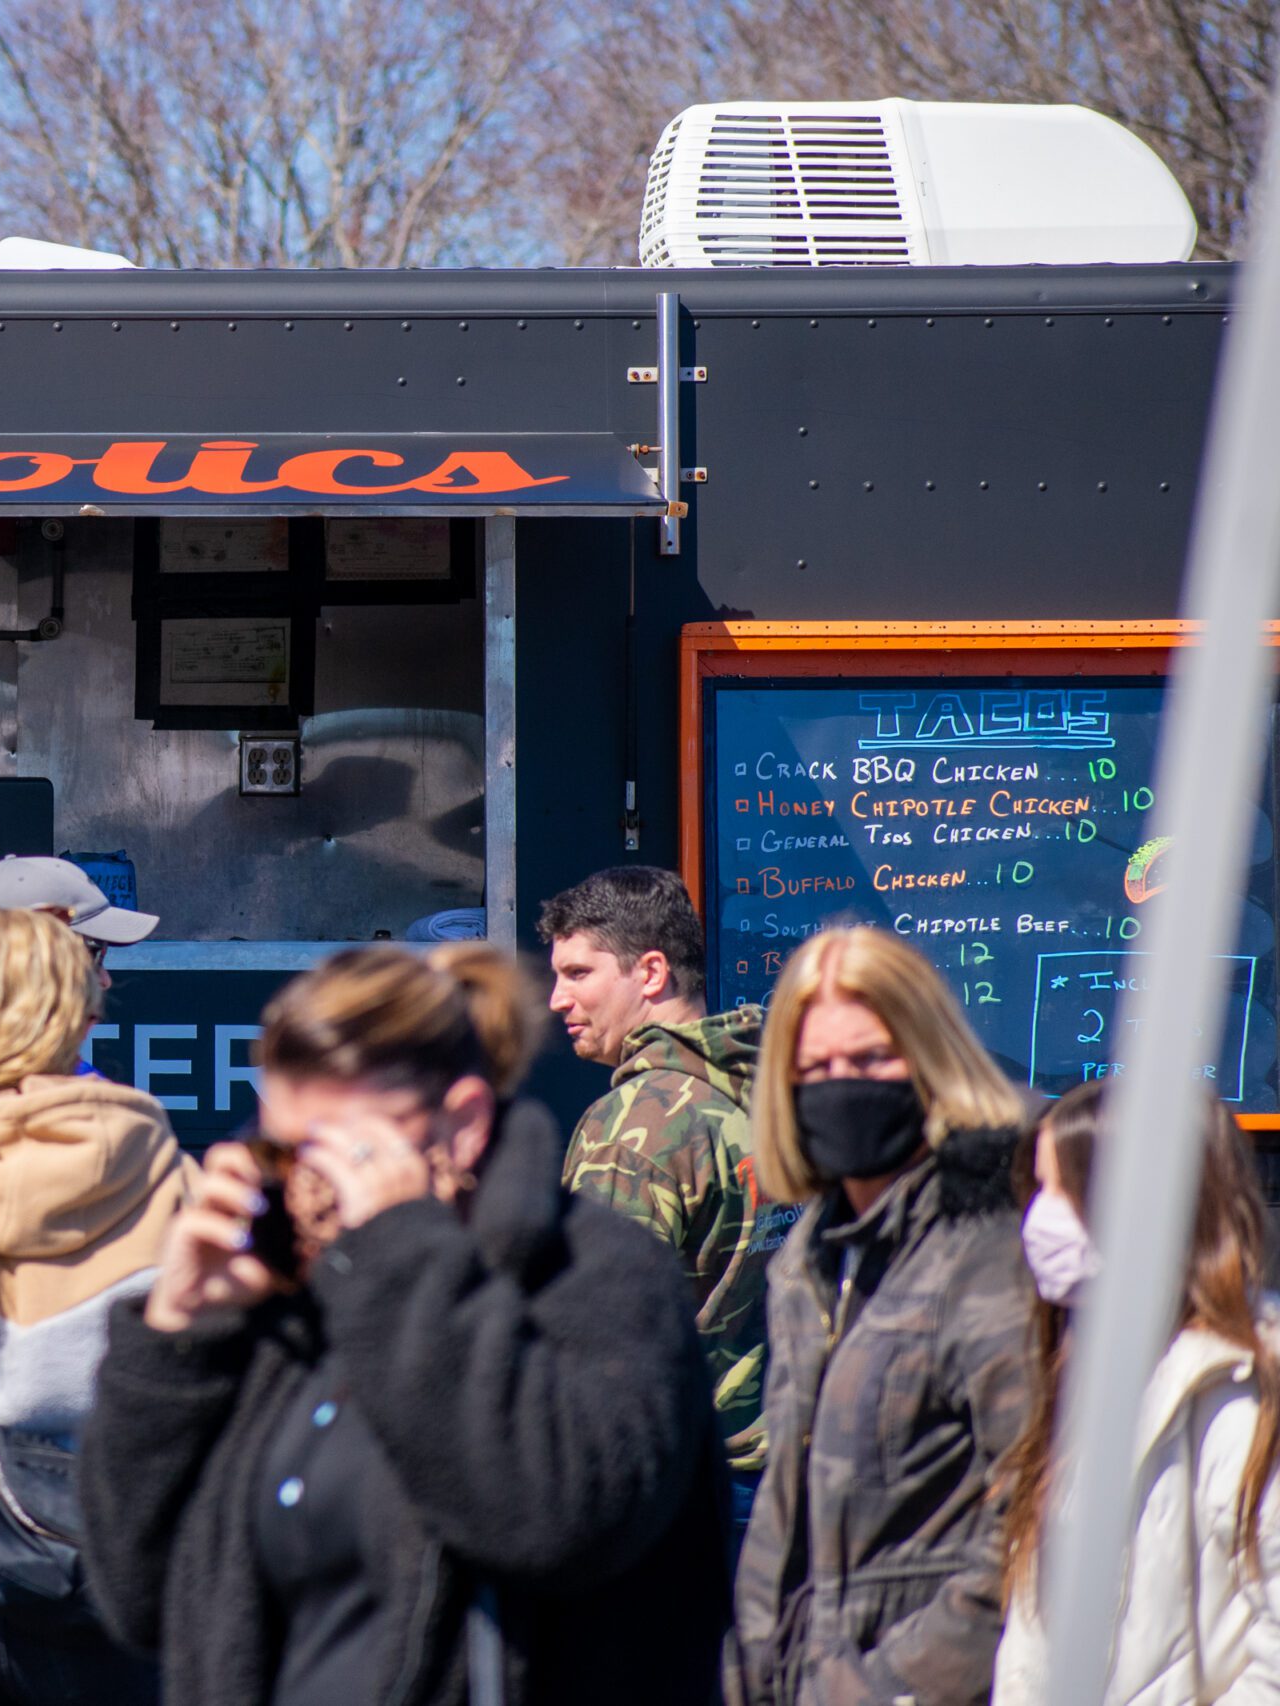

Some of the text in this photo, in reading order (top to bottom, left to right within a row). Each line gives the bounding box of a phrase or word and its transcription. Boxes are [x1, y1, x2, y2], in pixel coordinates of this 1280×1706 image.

[859, 690, 1109, 738] TACOS
[756, 752, 1117, 784] CRACK BBQ CHICKEN 10
[758, 787, 1155, 818] HONEY CHIPOTLE CHICKEN 10
[761, 830, 850, 852] GENERAL
[933, 822, 1032, 844] CHICKEN
[1065, 818, 1098, 843] 10
[758, 861, 1035, 899] BUFFALO CHICKEN 10
[894, 913, 1001, 934] CHIPOTLE
[1016, 914, 1070, 934] BEEF
[1105, 915, 1142, 940] 10
[960, 942, 995, 967] 12
[963, 981, 1002, 1006] 12
[1077, 1008, 1105, 1044] 2
[1082, 1062, 1126, 1083] PER
